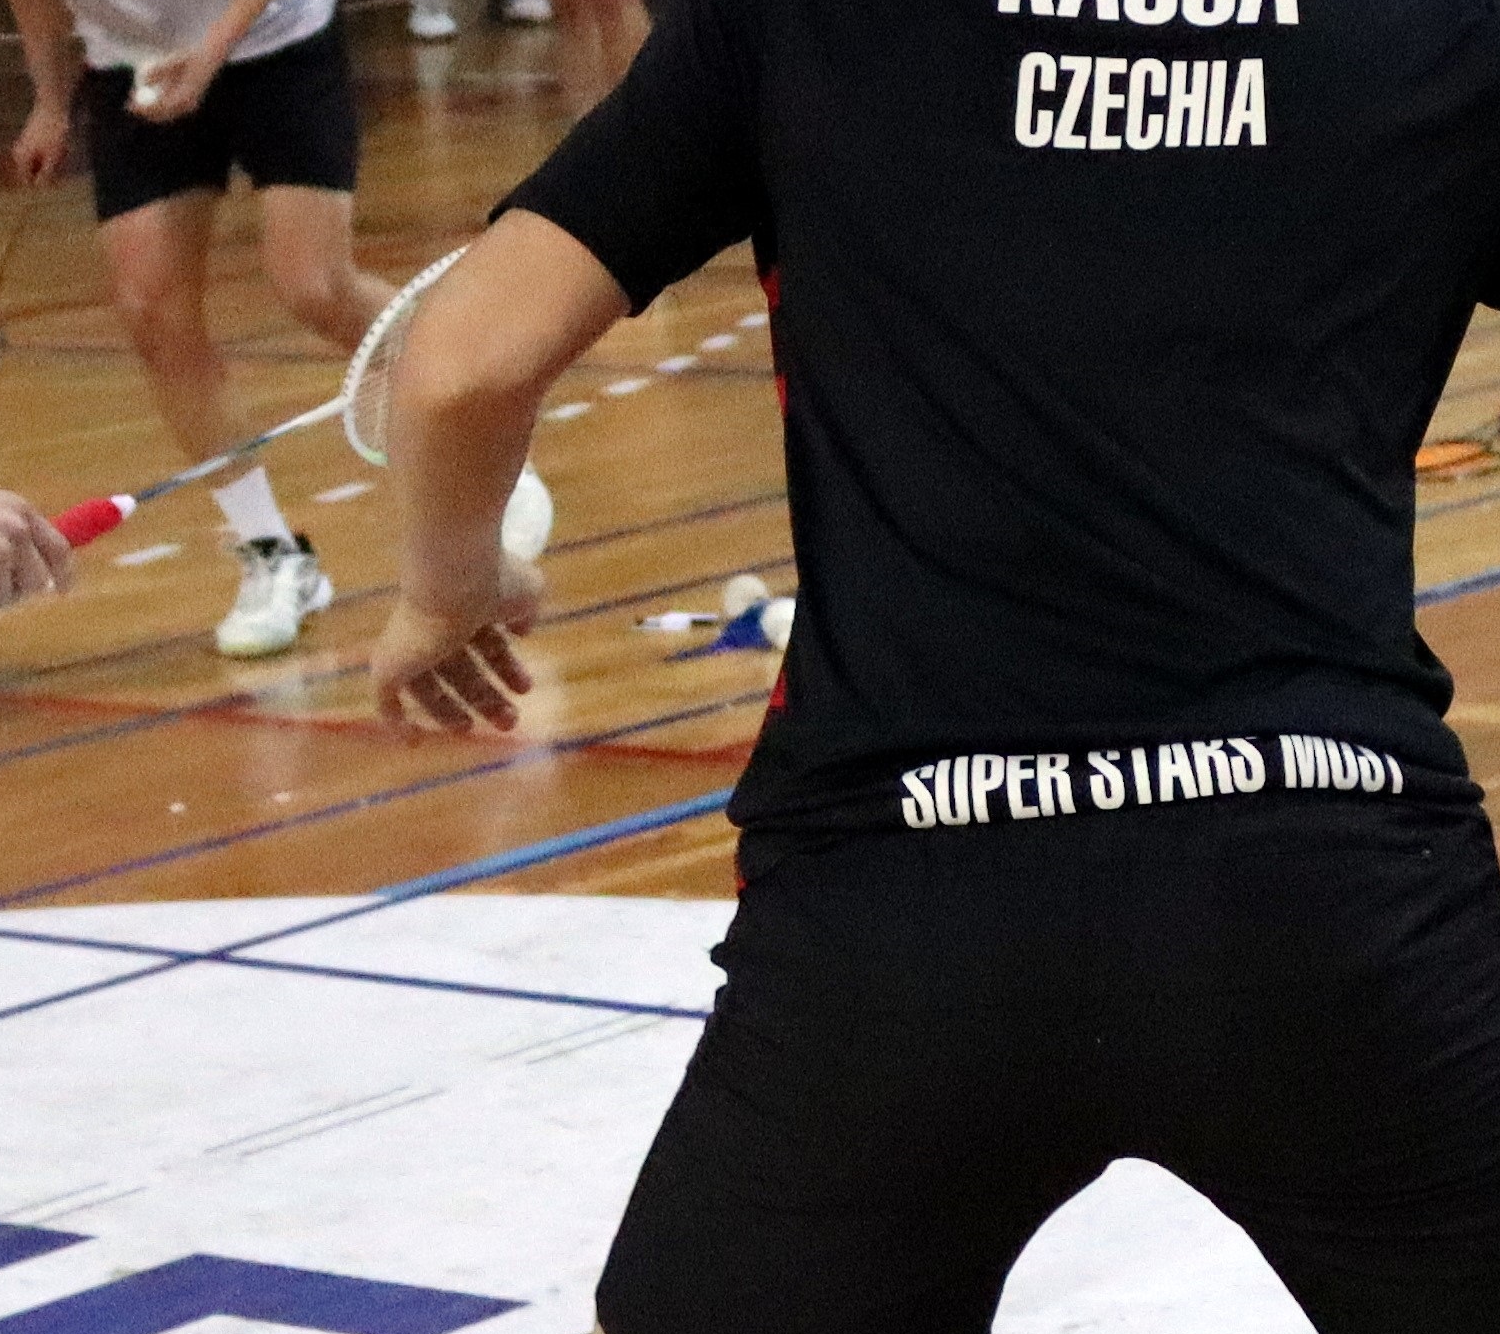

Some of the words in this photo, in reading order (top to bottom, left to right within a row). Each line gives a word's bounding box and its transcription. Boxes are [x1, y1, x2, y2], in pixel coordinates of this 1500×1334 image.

[1014, 51, 1267, 151] CZECHIA
[901, 754, 1076, 827] SUPER
[1087, 737, 1266, 810] STARS
